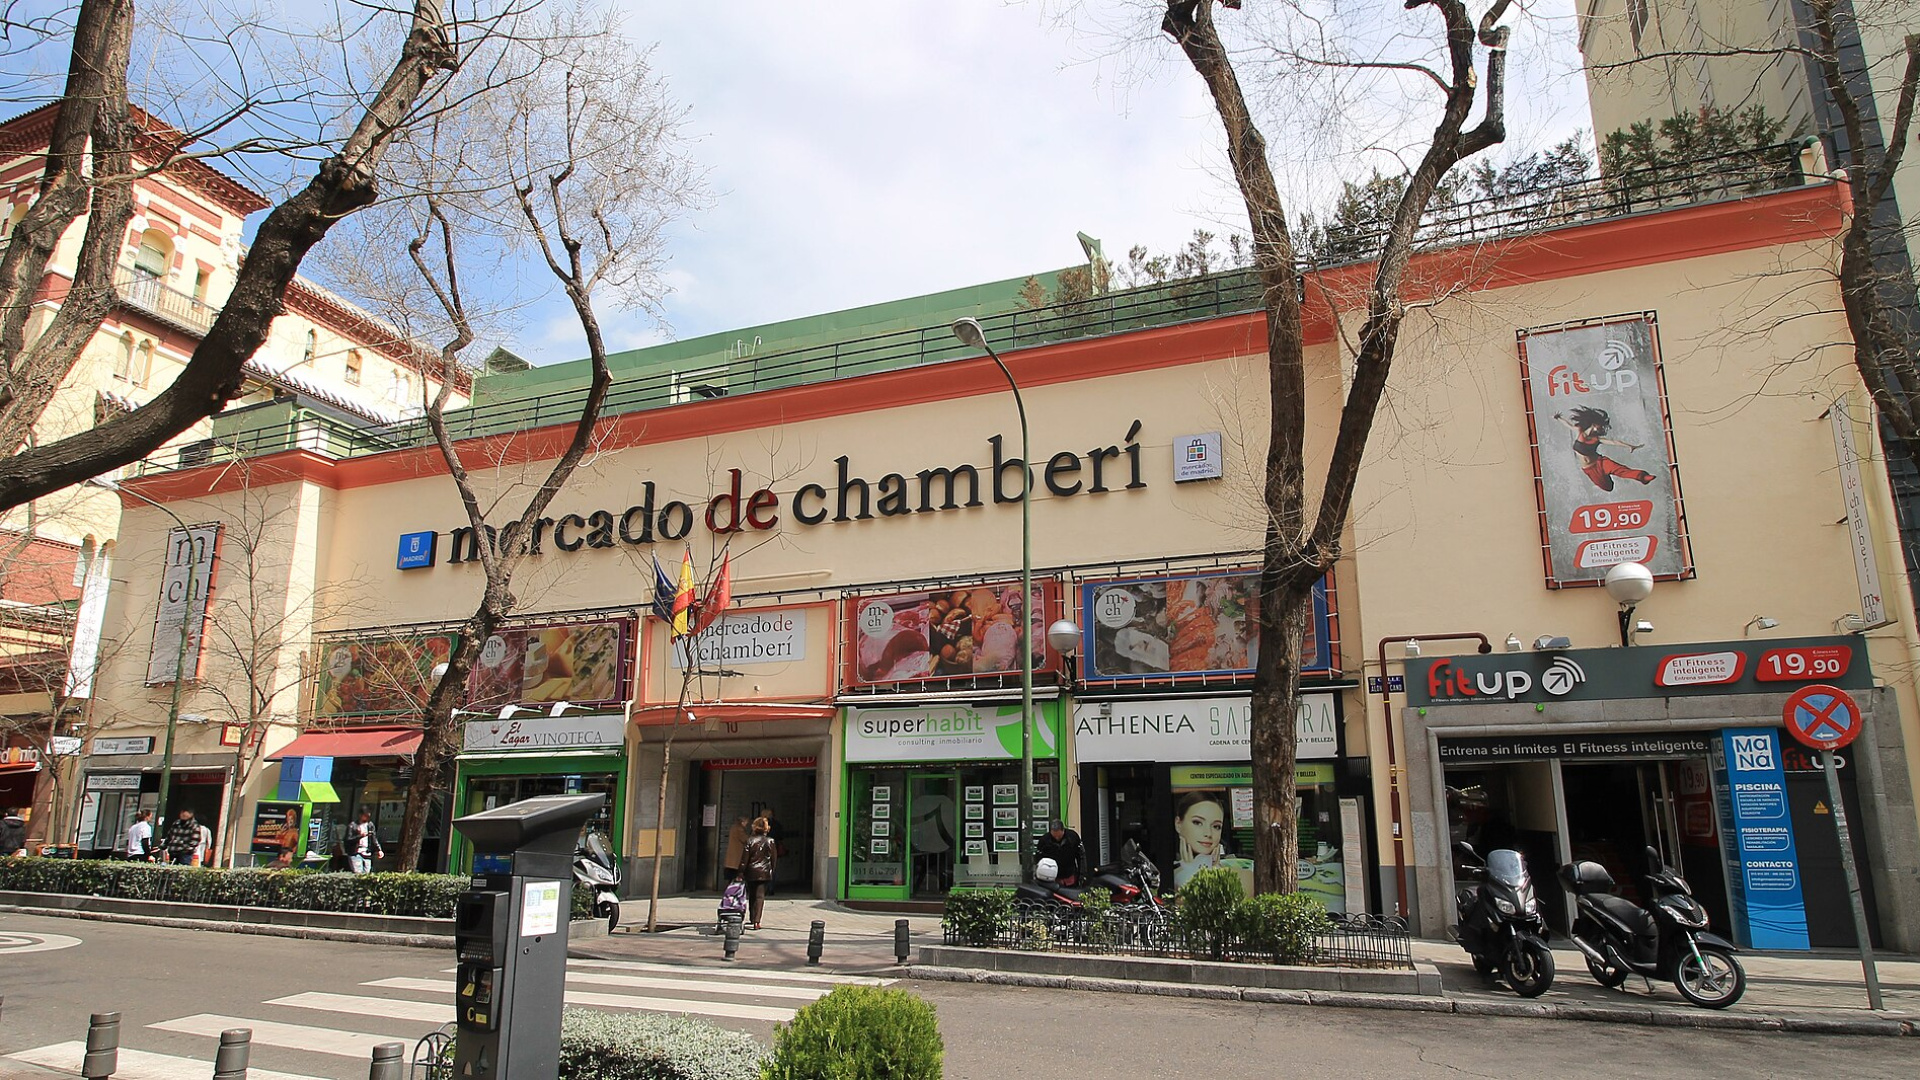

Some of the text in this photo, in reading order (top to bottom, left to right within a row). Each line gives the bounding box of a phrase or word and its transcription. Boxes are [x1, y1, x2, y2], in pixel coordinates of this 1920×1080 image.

[705, 468, 774, 534] de
[792, 419, 1147, 525] chamberí
[1847, 475, 1857, 490] de
[1579, 508, 1641, 529] 19,90
[1591, 548, 1640, 557] inteligente
[1603, 541, 1639, 550] Fitness
[1105, 594, 1121, 604] m
[868, 606, 882, 616] m
[1105, 603, 1121, 616] ch
[1865, 606, 1878, 623] ch
[867, 615, 882, 627] ch
[700, 635, 793, 661] chamberí
[1686, 658, 1725, 666] Fitness
[1768, 653, 1840, 675] 19,90
[1673, 666, 1726, 675] inteligente
[508, 721, 522, 735] El
[863, 711, 984, 738] superhabit
[1076, 714, 1195, 735] ATHENEA
[500, 731, 604, 748] Lagar VINOTECA
[898, 736, 983, 746] consulting inmobiliario
[1440, 740, 1708, 756] Entrena sin límites El Fitness inteligente.
[1735, 783, 1782, 791] PISCINA
